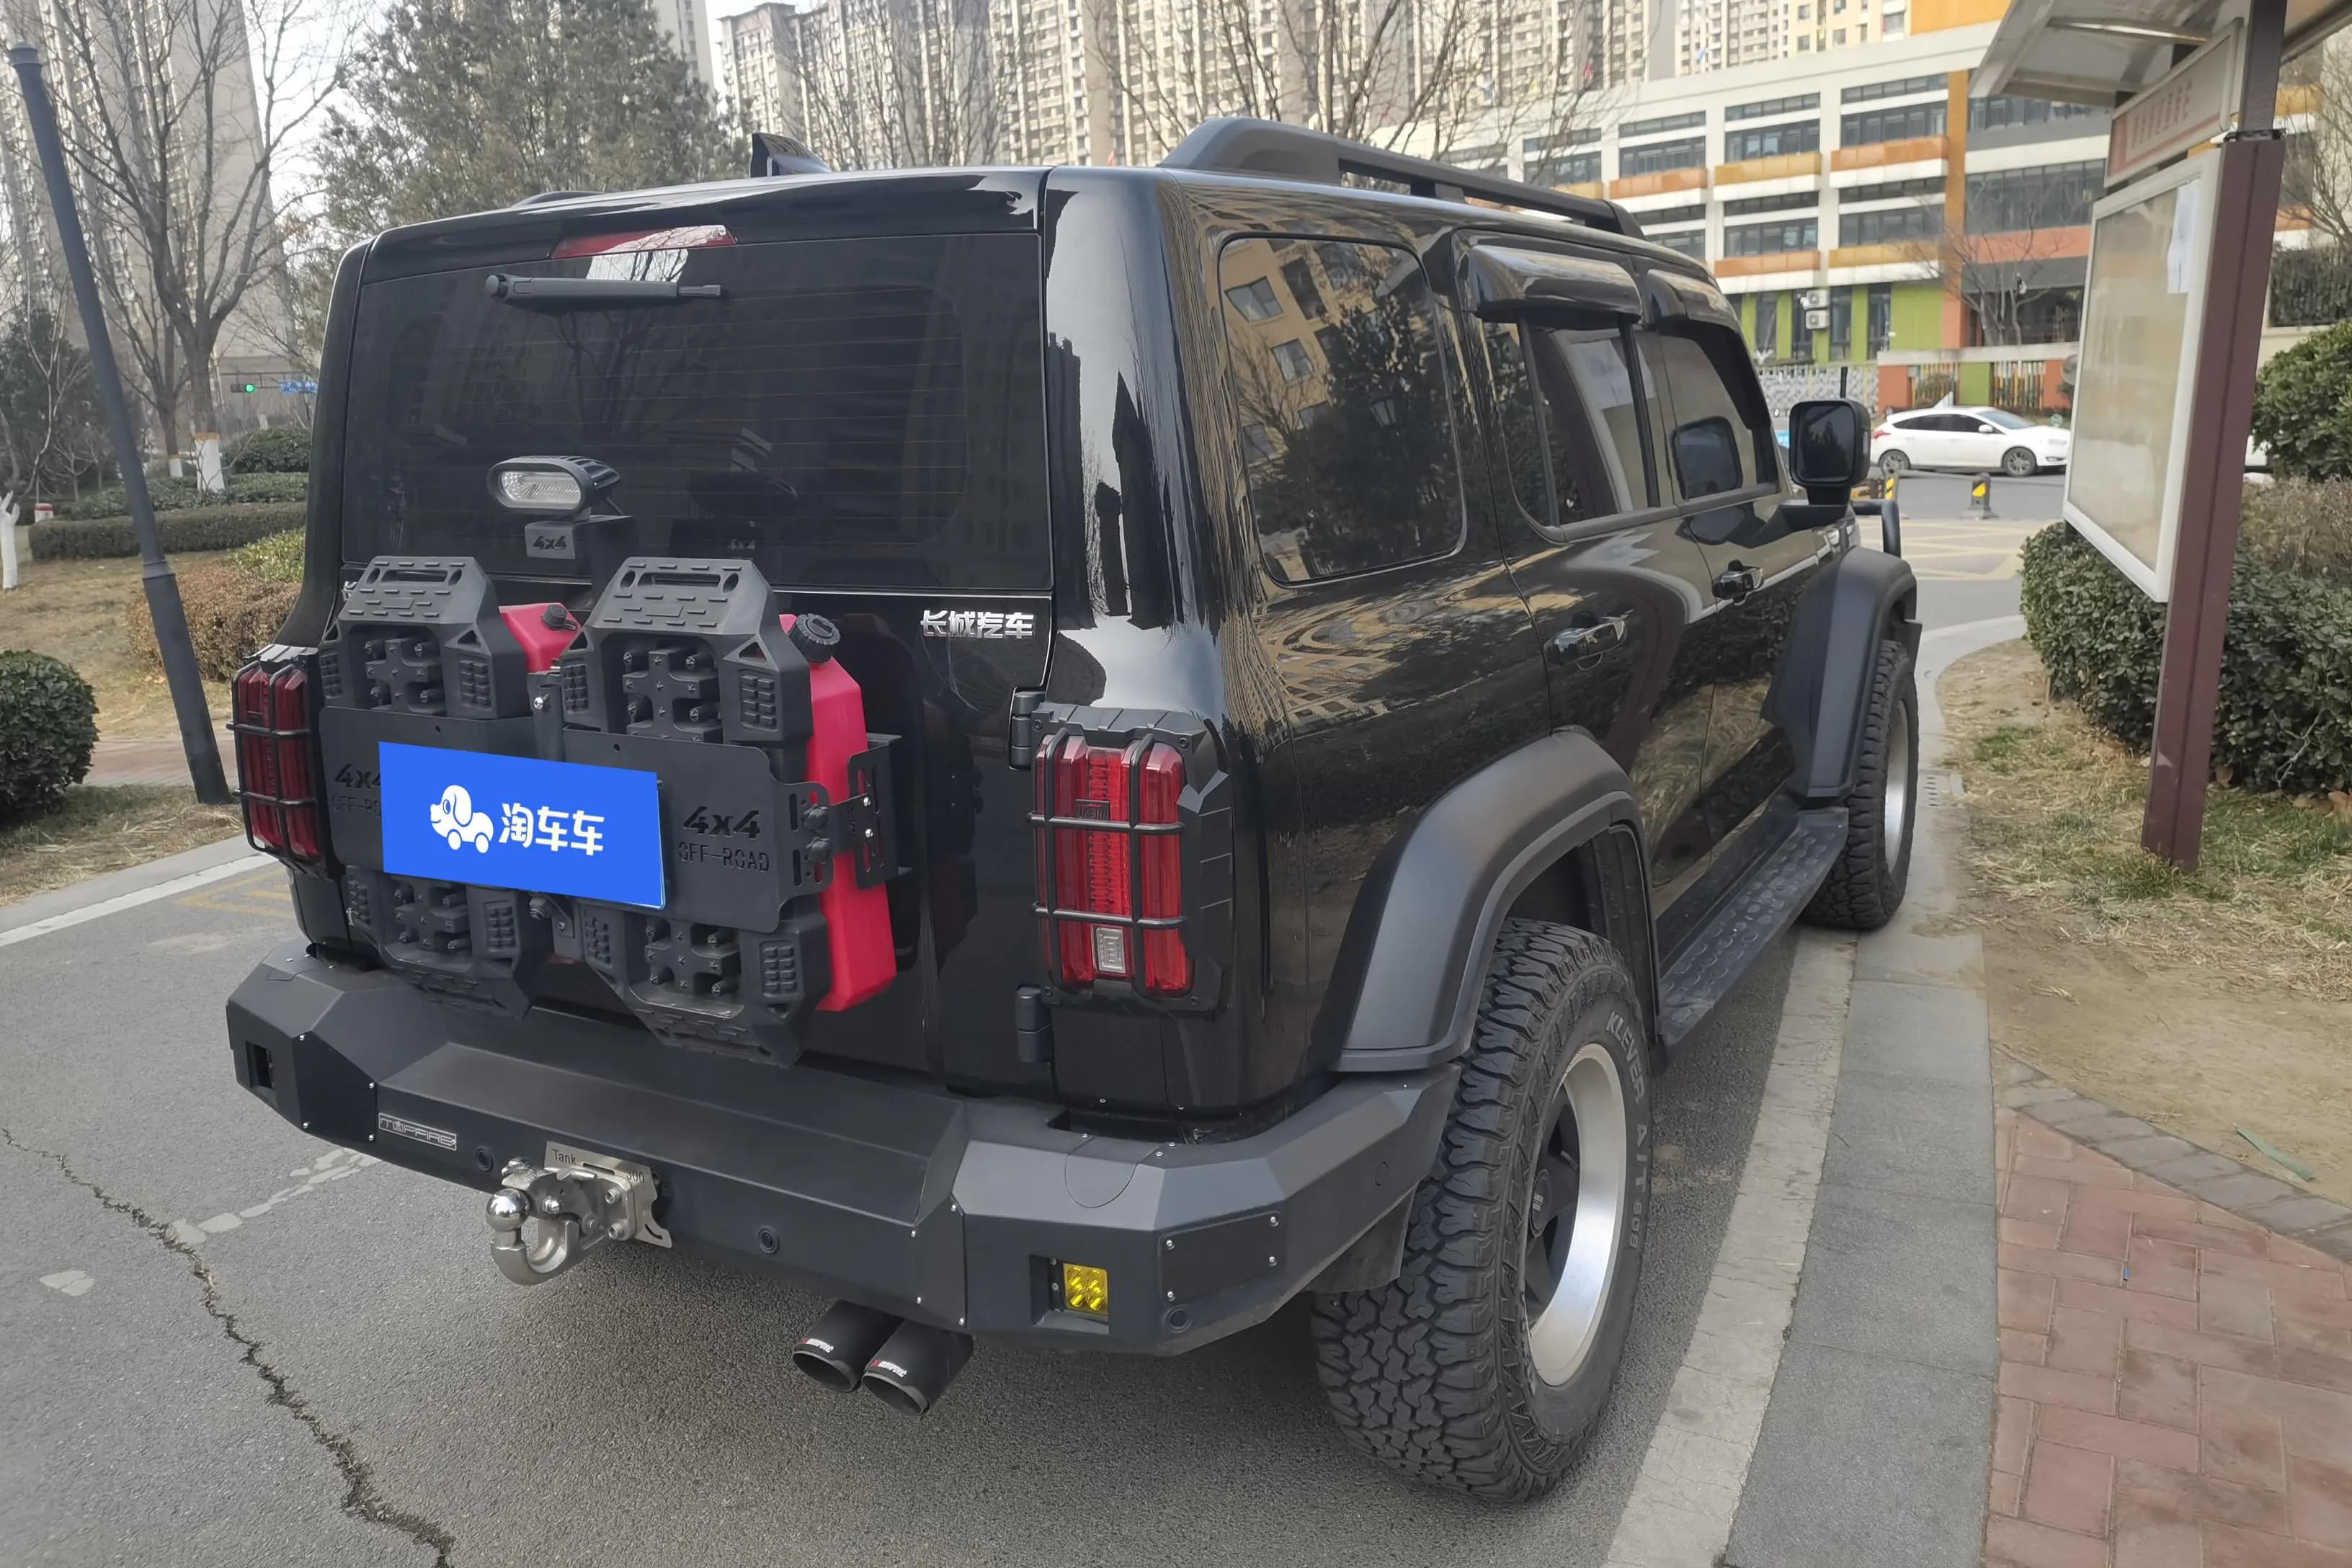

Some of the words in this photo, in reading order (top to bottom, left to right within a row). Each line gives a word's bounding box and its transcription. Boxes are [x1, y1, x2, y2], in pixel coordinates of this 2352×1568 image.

[533, 535, 566, 550] 4x4
[920, 610, 1035, 639] 长城汽车
[683, 806, 760, 840] 4x4
[679, 842, 770, 872] OFF-ROAD
[1606, 1011, 1644, 1104] KLEVER
[551, 1149, 577, 1165] Tank
[626, 1168, 646, 1183] 300
